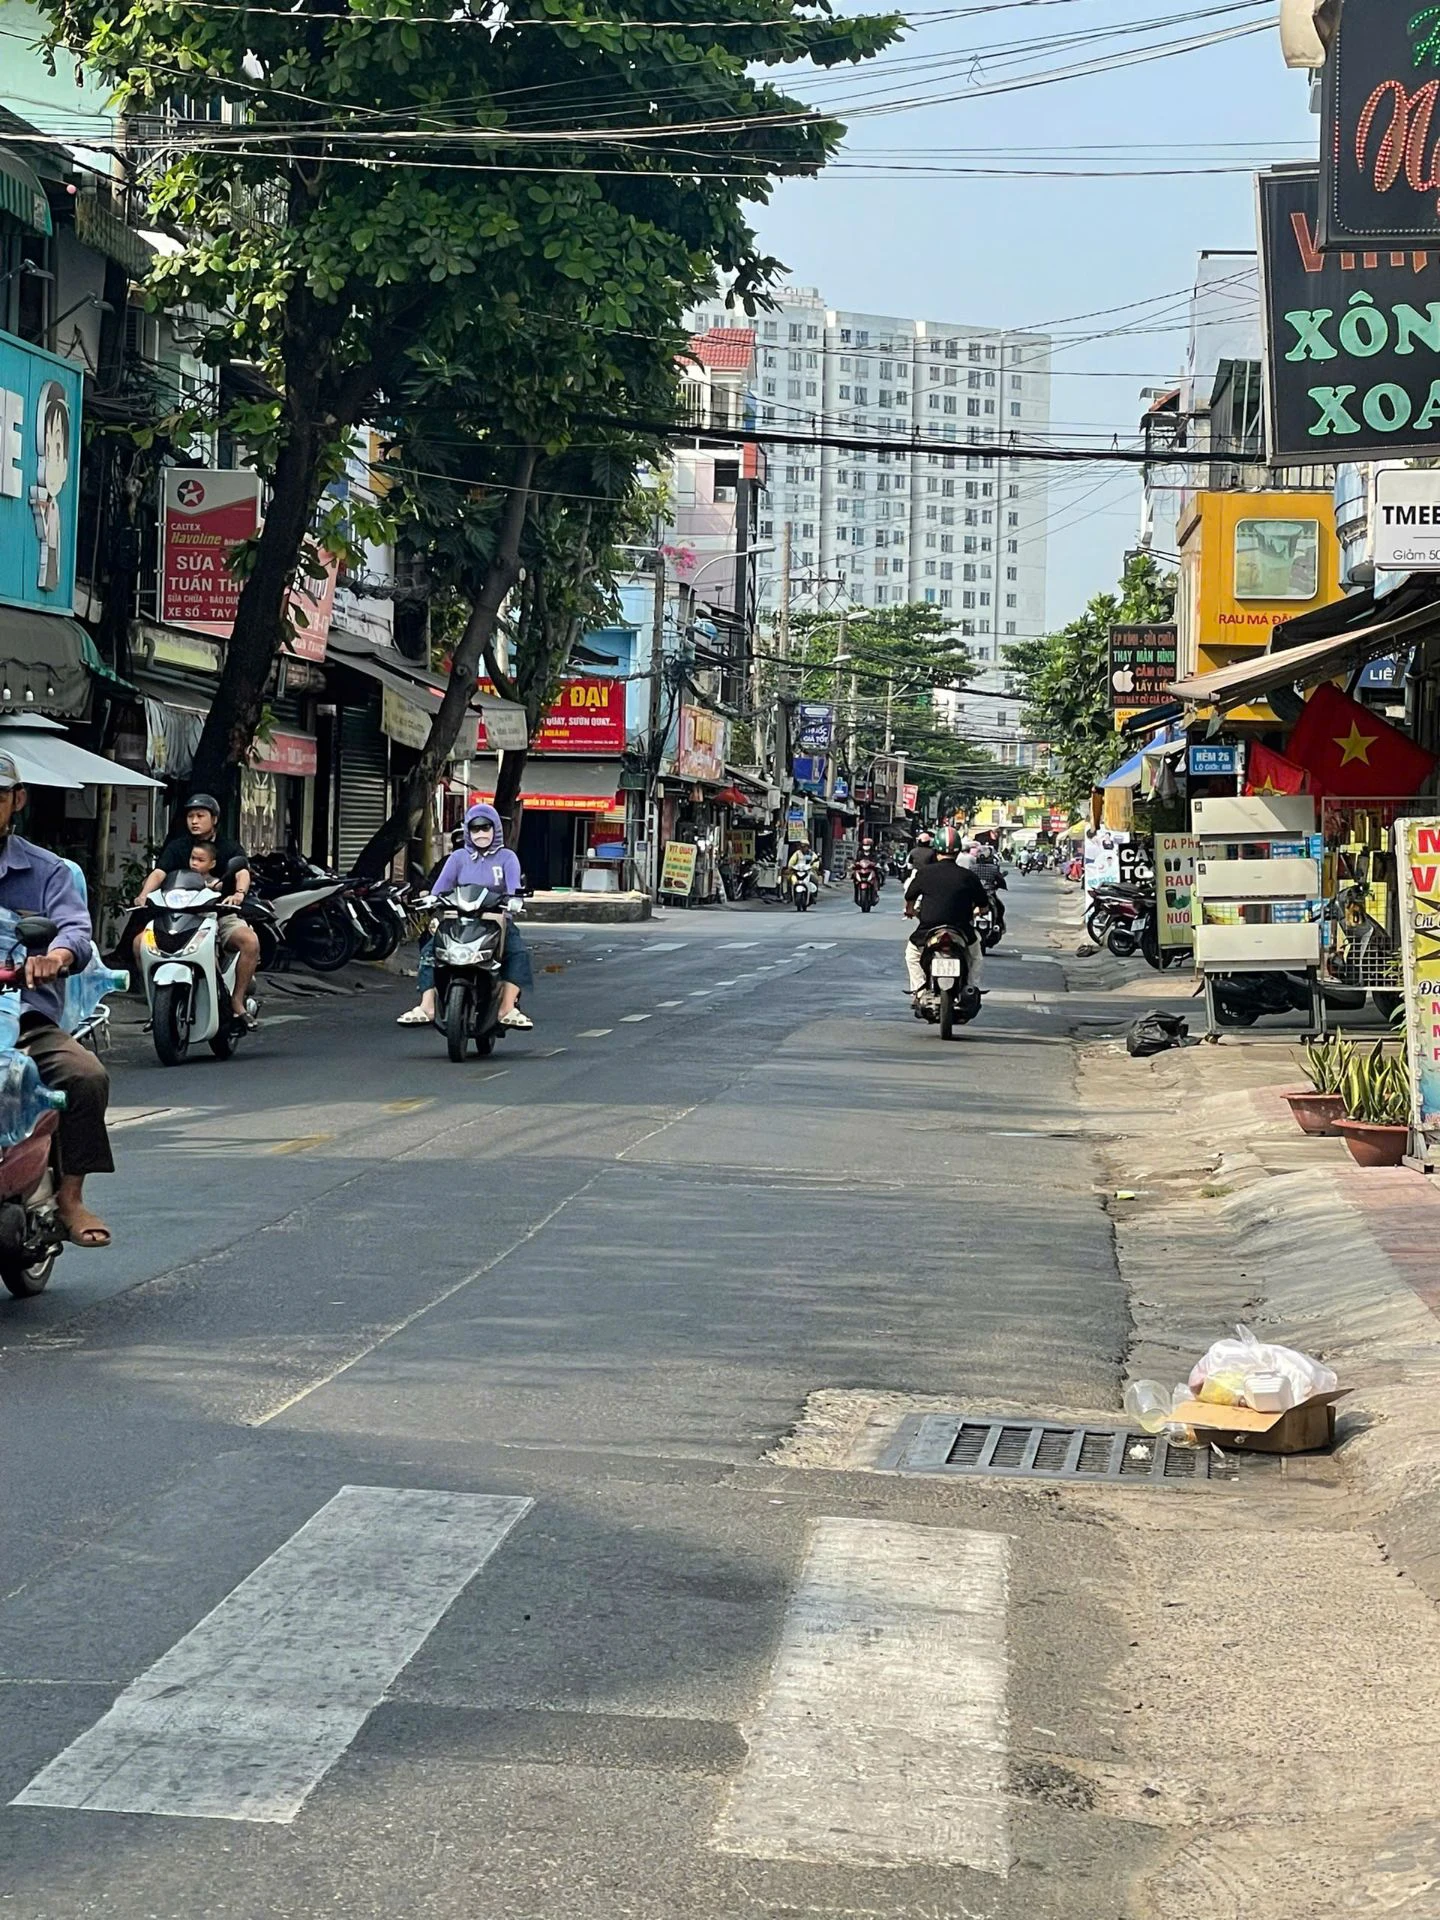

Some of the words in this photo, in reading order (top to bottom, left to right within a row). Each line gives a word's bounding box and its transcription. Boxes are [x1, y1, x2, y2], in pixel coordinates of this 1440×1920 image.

[171, 523, 201, 531] CALTEX
[171, 532, 222, 545] Havoline
[176, 551, 215, 571] SỬA
[1393, 549, 1426, 560] Giảm
[169, 573, 213, 591] TUẤN
[168, 607, 181, 617] XE
[185, 604, 200, 617] SỐ
[211, 608, 231, 618] TAY
[1218, 614, 1245, 625] RAU
[1247, 612, 1269, 625] MÁ
[1113, 650, 1133, 663] THAY
[1370, 667, 1396, 680] LIÊ
[570, 686, 609, 712] ĐẠI
[1196, 750, 1216, 761] HẺM
[492, 866, 503, 885] P
[1165, 875, 1193, 886] RAU
